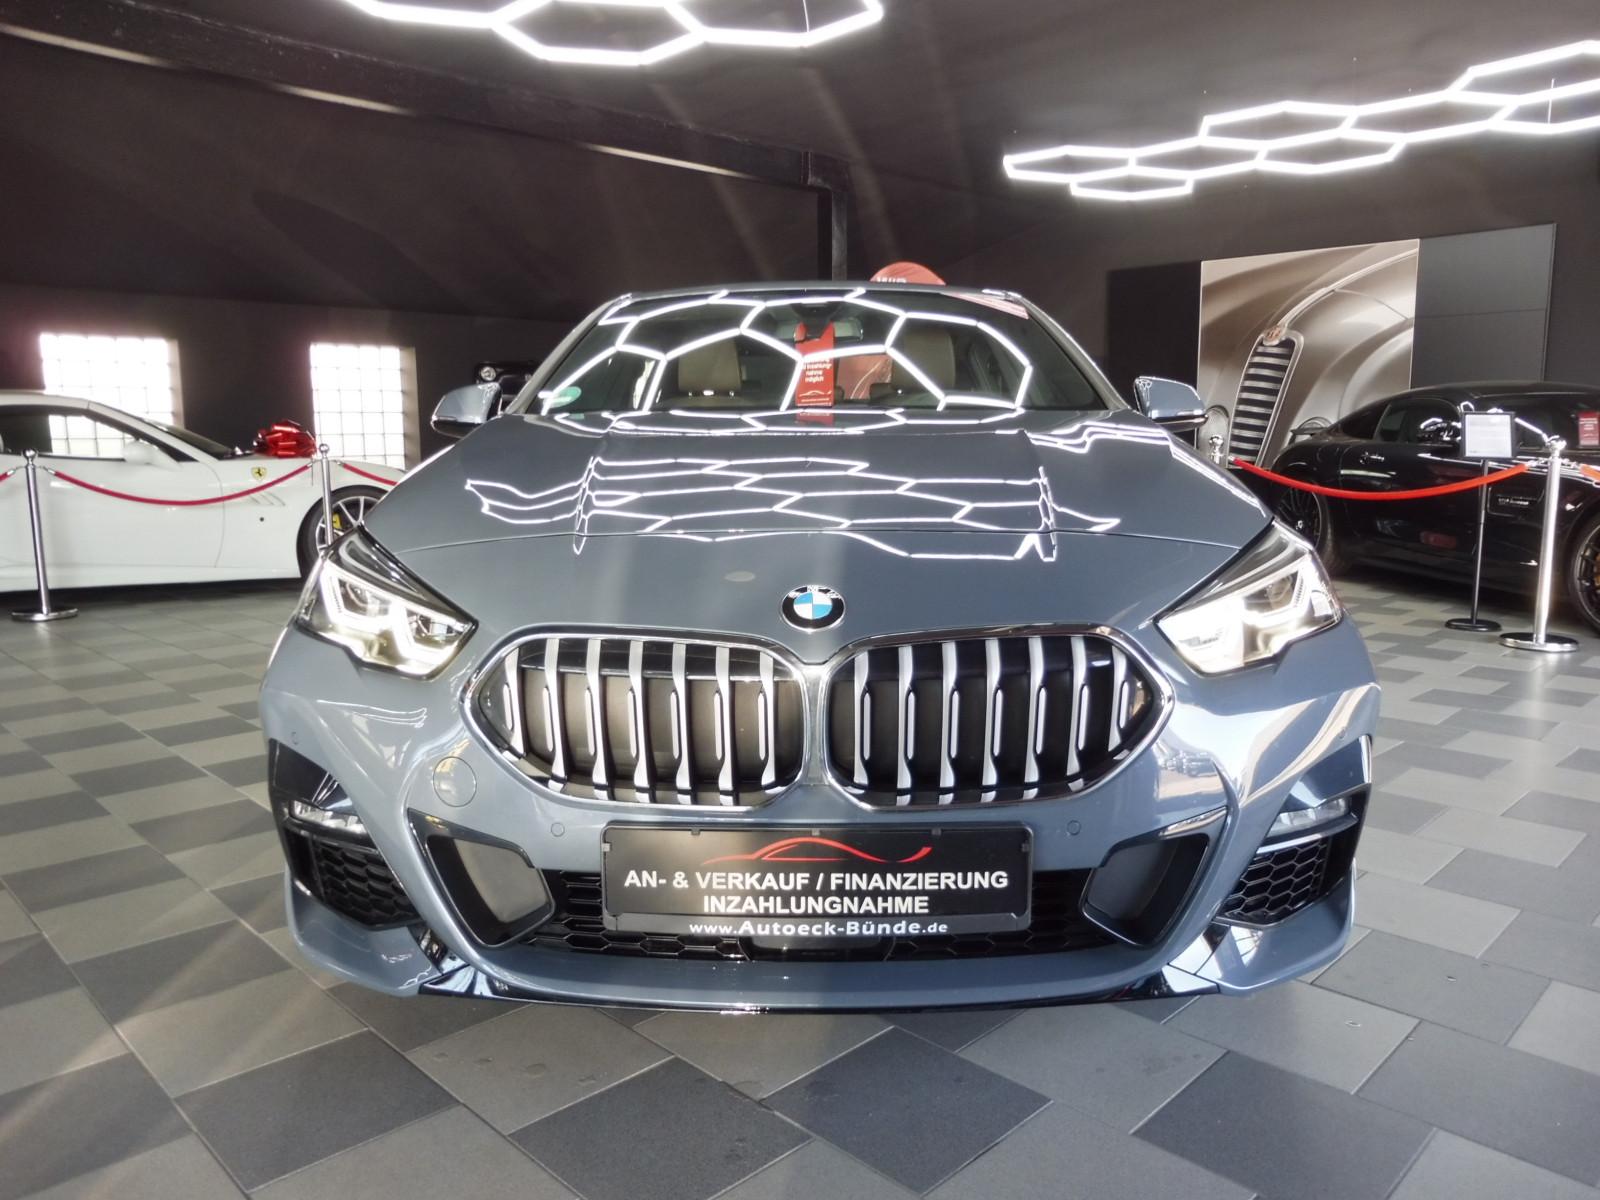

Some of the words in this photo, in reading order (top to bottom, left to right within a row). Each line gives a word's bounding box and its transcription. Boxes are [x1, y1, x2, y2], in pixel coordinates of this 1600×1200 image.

[623, 870, 667, 888] AN-
[672, 871, 689, 888] &
[695, 872, 811, 890] VERKAUF
[830, 871, 1009, 890] FINANZIERUNG
[703, 895, 930, 914] INZAHLUNGNAHME
[689, 920, 949, 936] www.Autoeck-Bünde.de
